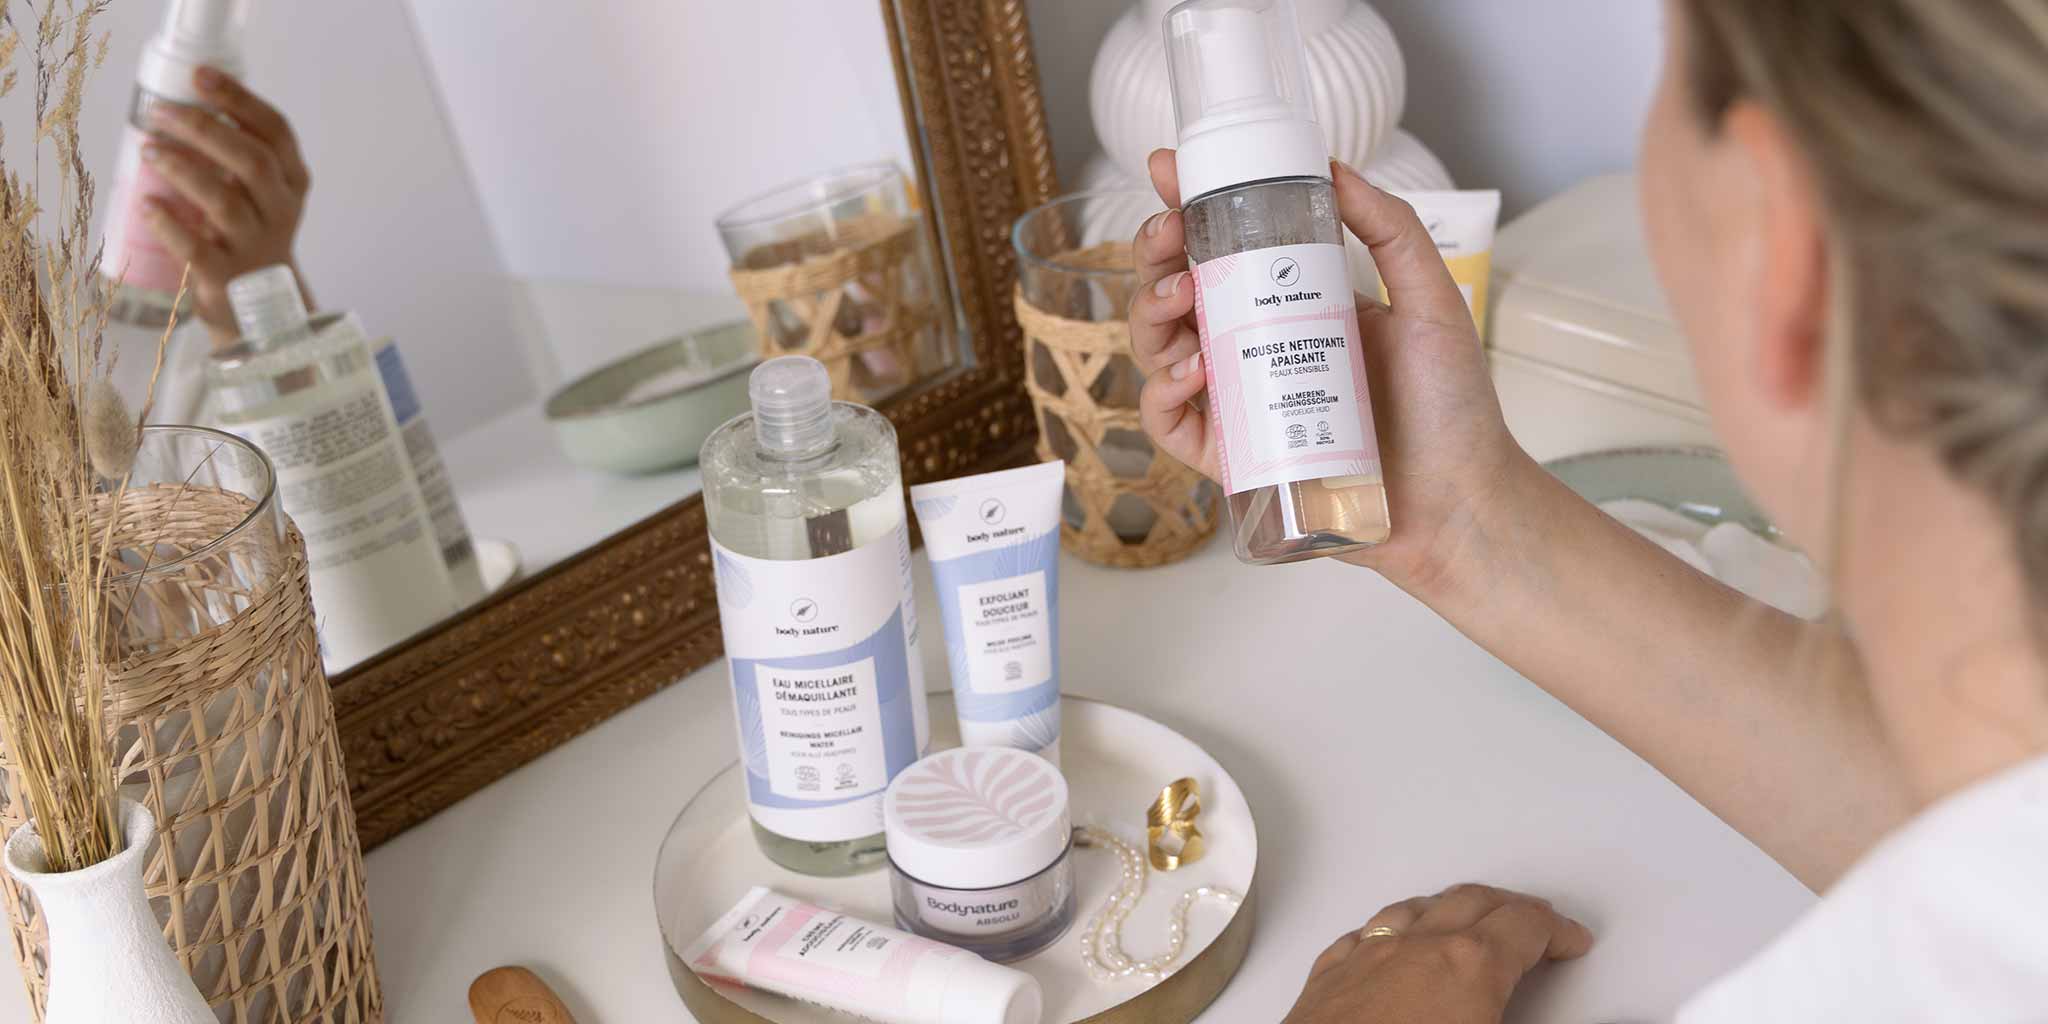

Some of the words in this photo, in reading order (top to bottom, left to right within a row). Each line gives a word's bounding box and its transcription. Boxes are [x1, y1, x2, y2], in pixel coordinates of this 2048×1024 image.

[1255, 293, 1282, 307] body
[1284, 289, 1322, 303] nature
[1242, 342, 1285, 360] MOUSSE
[1289, 337, 1345, 352] NETTOYANTE
[1270, 351, 1326, 368] APAISANTE
[1269, 369, 1292, 378] PEAUX
[1294, 364, 1329, 375] SENSIBLES
[1269, 395, 1338, 411] REINIGINGSSCHUIM
[1281, 389, 1326, 401] KALMEREND
[967, 532, 990, 544] body
[992, 526, 1025, 538] nature
[979, 588, 1029, 606] EXFOLIANT
[982, 602, 1029, 618] DOUCEUR
[776, 626, 799, 638] body
[802, 624, 839, 636] nature
[773, 678, 791, 689] EAU
[794, 674, 854, 690] MICELLAIRE
[775, 686, 857, 702] DÉMAQUILLANTE
[927, 897, 1019, 917] Bodynature
[976, 912, 1020, 926] ABSOLU
